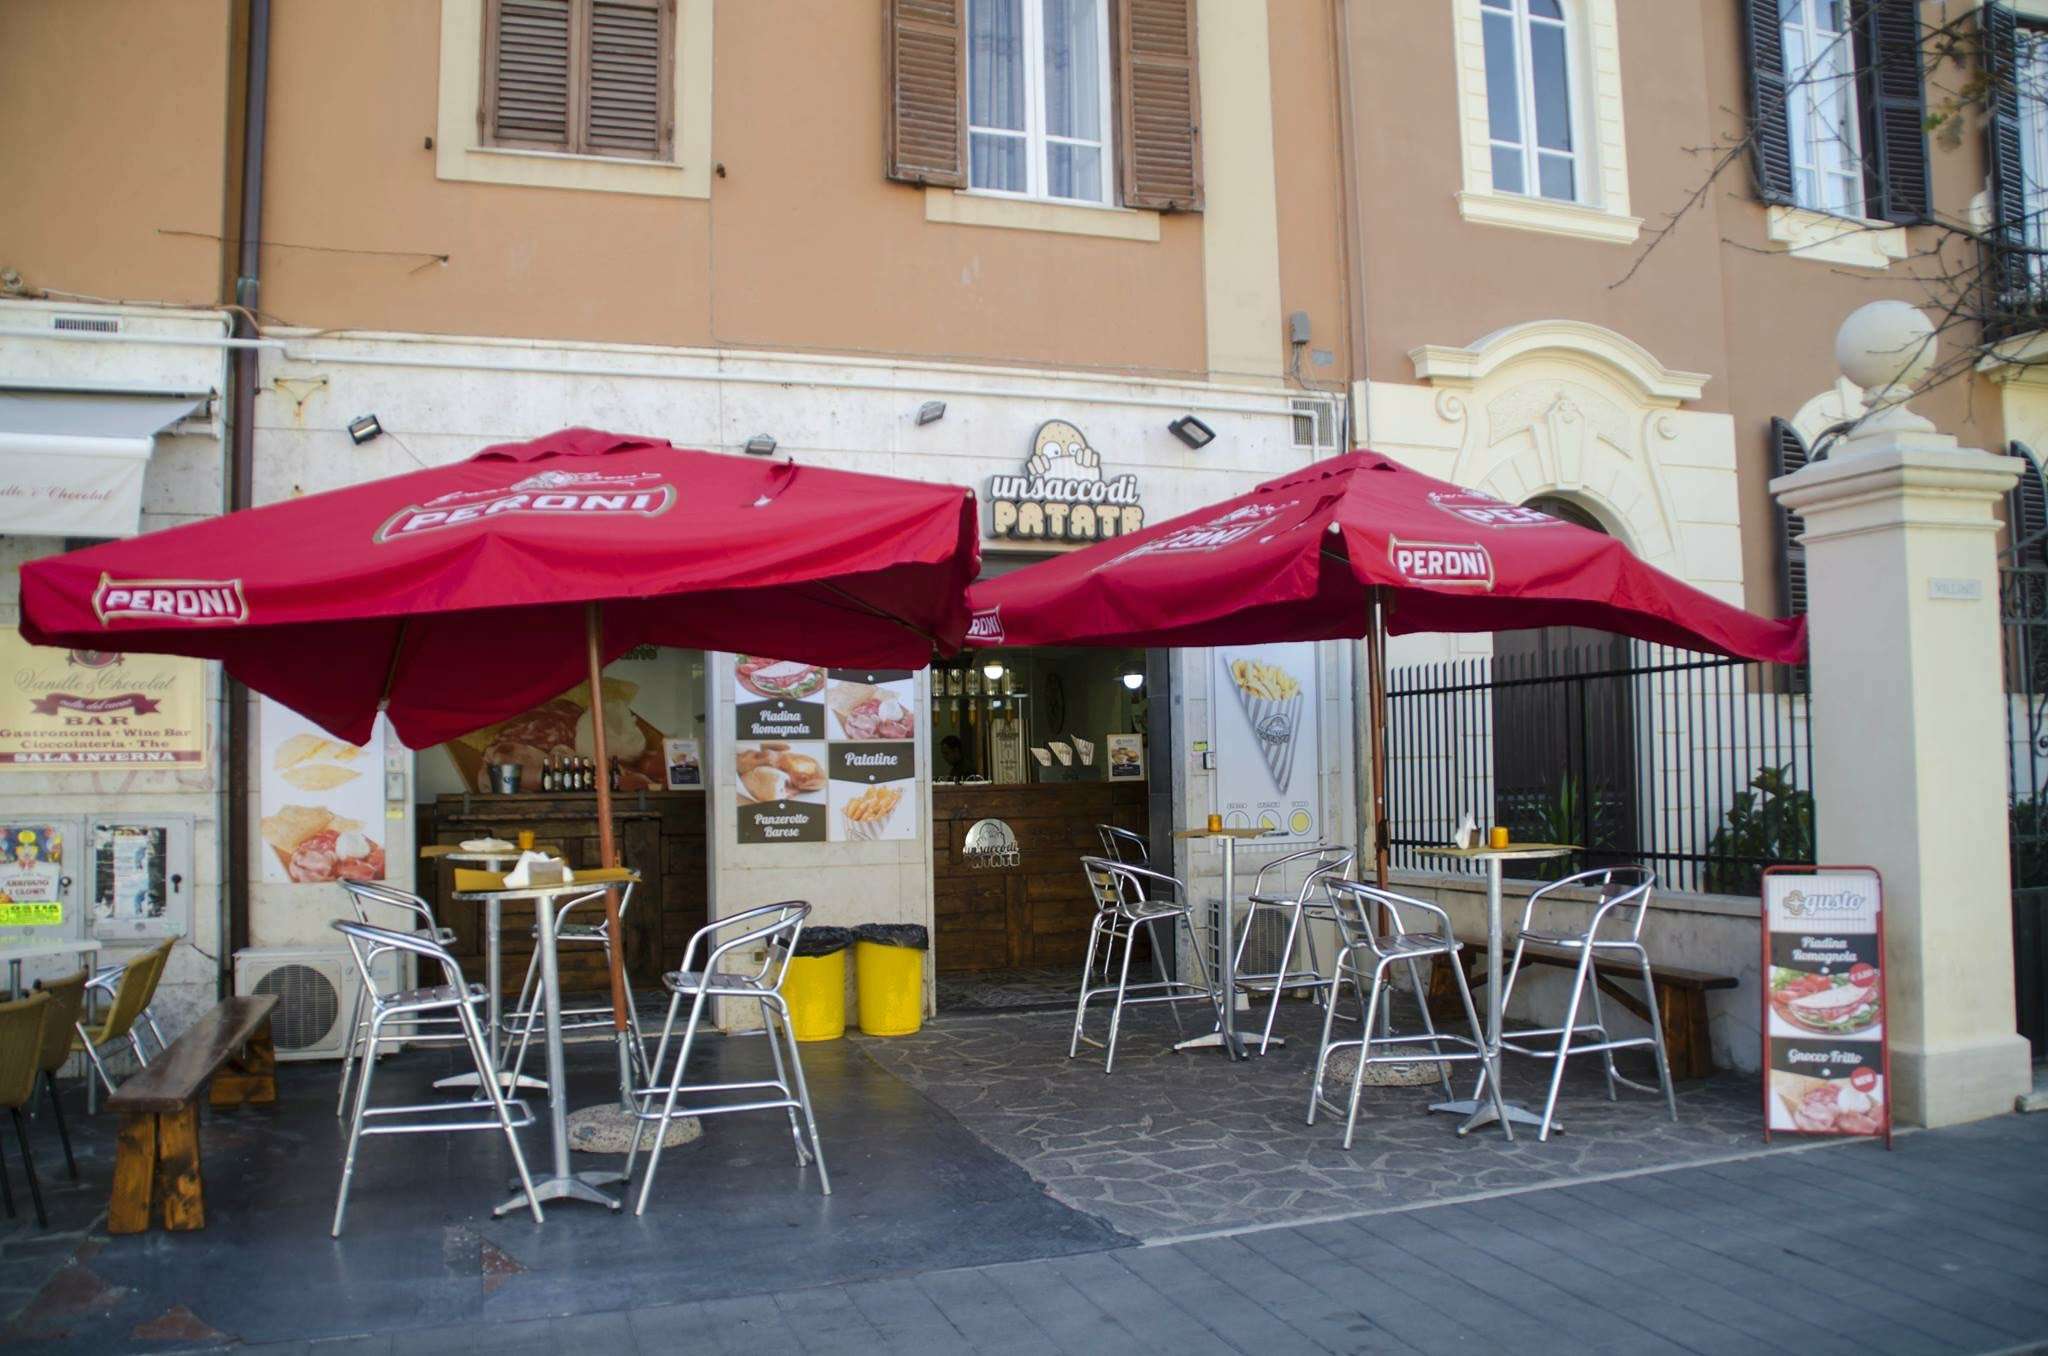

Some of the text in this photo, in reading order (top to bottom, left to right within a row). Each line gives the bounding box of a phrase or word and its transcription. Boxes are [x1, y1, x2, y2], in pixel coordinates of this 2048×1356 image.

[48, 486, 114, 501] Chocolat
[402, 494, 651, 531] PERONI
[994, 500, 1144, 537] PATATE
[1397, 550, 1486, 576] PERONI
[105, 589, 236, 616] PERONI
[967, 615, 1000, 636] RONI
[14, 668, 81, 692] Vanille
[96, 668, 175, 690] Chocolat
[65, 716, 129, 726] BAR
[760, 709, 801, 723] Piadina
[0, 728, 191, 738] Gastronomia Wine Bar
[751, 723, 810, 738] Romagnola
[20, 740, 125, 749] Cioccolateria
[14, 752, 176, 762] SALA INTERNA
[845, 752, 898, 766] Patatine
[754, 813, 809, 826] Panzerotto
[764, 827, 799, 838] Barese
[1801, 936, 1848, 949] Piadina
[1792, 949, 1858, 965] Romagnola
[1788, 1048, 1863, 1064] Gnocco Fritto
